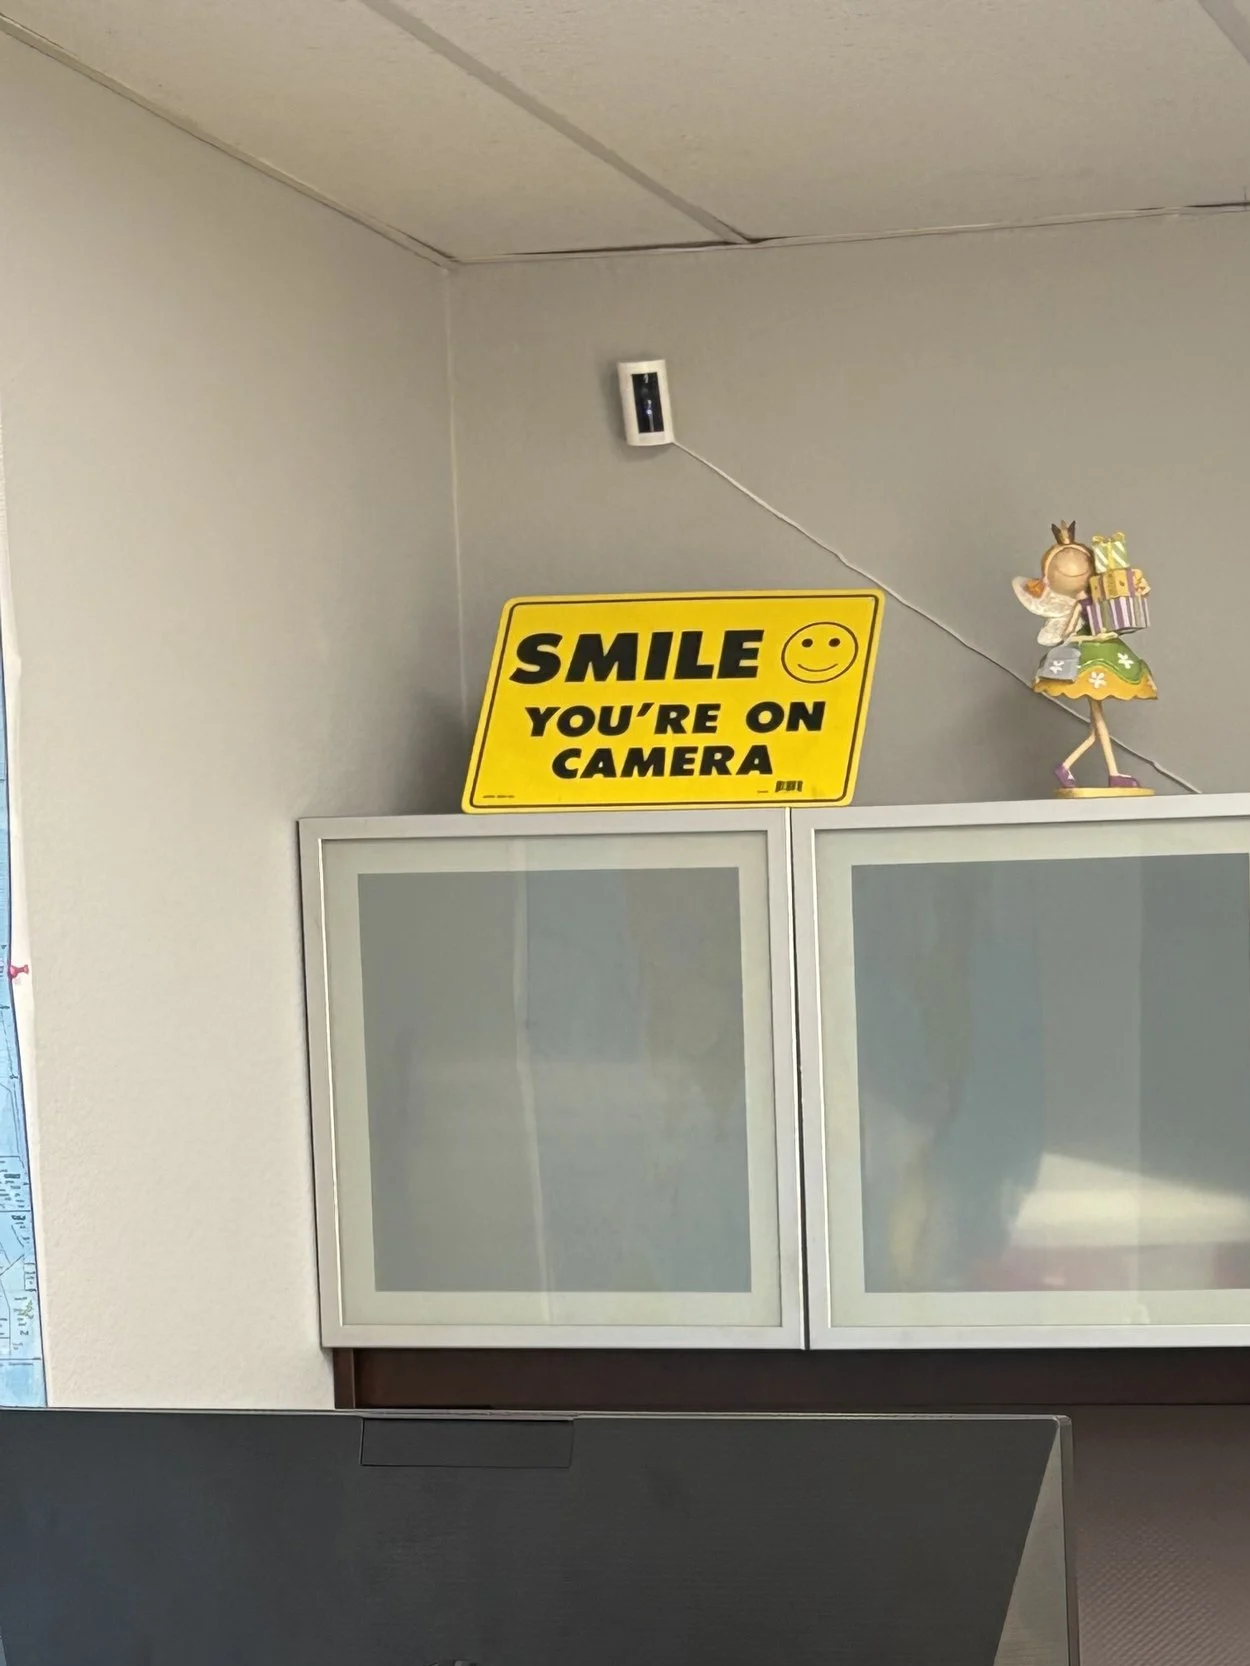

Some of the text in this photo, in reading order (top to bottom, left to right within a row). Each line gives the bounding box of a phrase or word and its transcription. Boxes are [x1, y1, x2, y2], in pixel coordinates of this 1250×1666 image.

[509, 629, 765, 685] SMILE
[524, 701, 826, 737] YOU'RE ON
[551, 744, 774, 779] CAMERA
